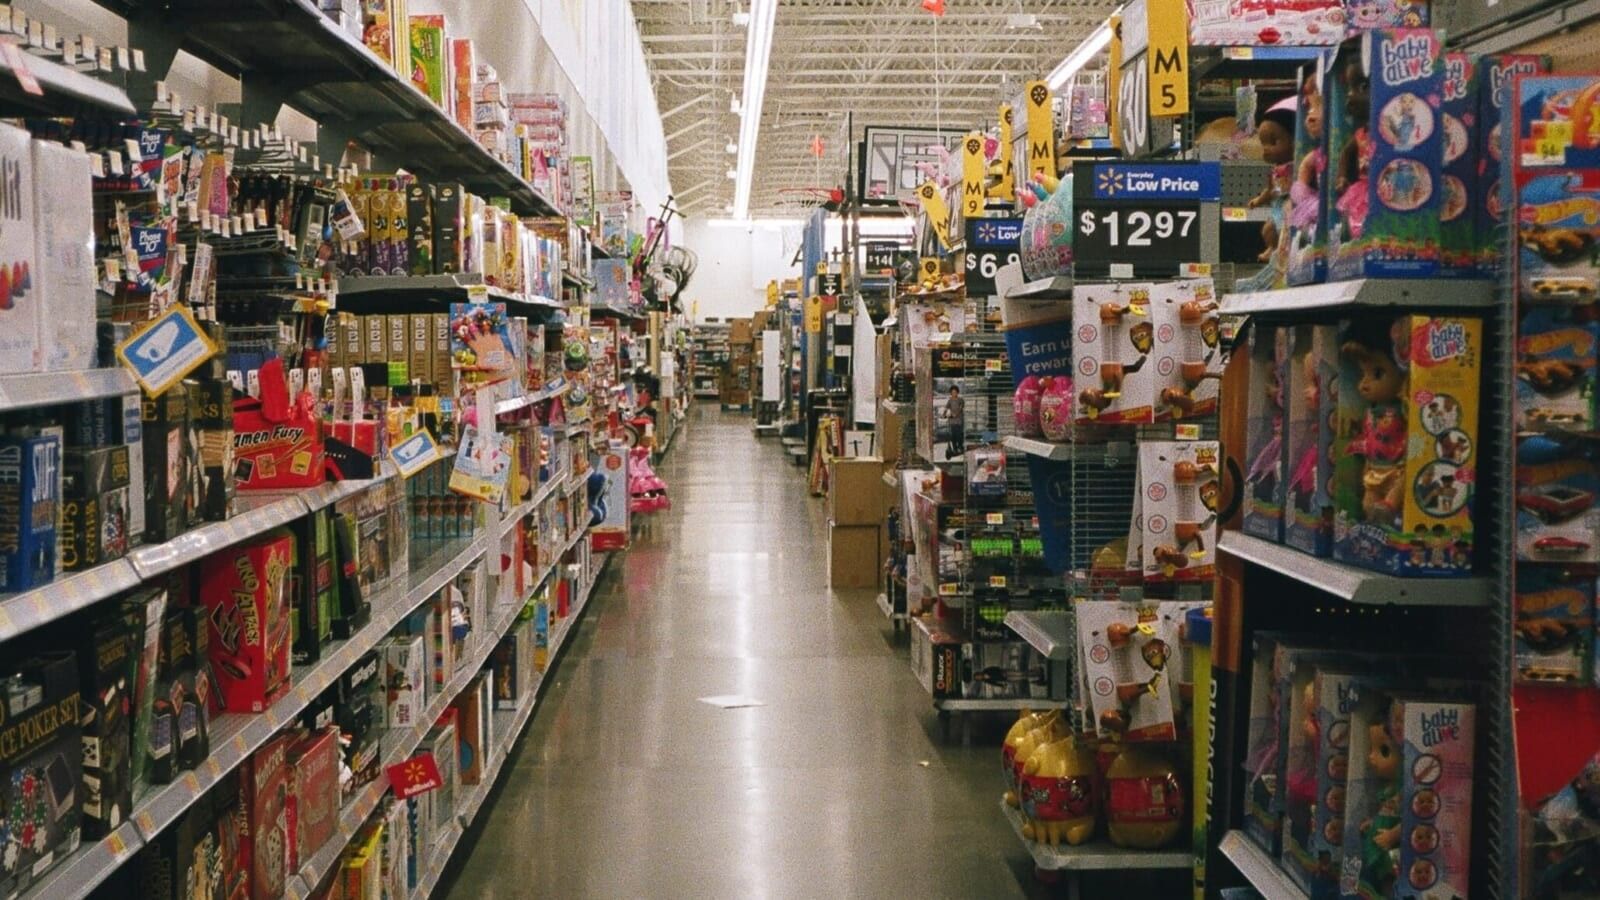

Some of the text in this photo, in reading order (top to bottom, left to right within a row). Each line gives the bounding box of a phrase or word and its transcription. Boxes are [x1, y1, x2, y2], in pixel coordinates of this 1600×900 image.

[1382, 37, 1429, 62] baby
[1153, 47, 1182, 74] M
[1383, 59, 1431, 84] alive
[1161, 85, 1176, 108] 5
[141, 131, 160, 144] Phase
[144, 143, 157, 153] 10
[1032, 141, 1050, 160] M
[965, 182, 981, 195] M
[1127, 177, 1200, 191] Low Price
[968, 201, 978, 213] 9
[139, 230, 161, 243] Phase
[998, 231, 1021, 240] Low
[144, 242, 158, 253] 10
[1431, 325, 1463, 345] baby
[1021, 341, 1057, 356] Earn
[1432, 338, 1465, 359] alive
[235, 426, 304, 448] amen Fury
[235, 555, 260, 593] UNO
[232, 590, 261, 647] ATTACK
[936, 654, 945, 681] Razor
[19, 706, 56, 748] POKER
[60, 691, 81, 727] SET
[1421, 708, 1458, 732] baby
[1422, 725, 1460, 747] alive
